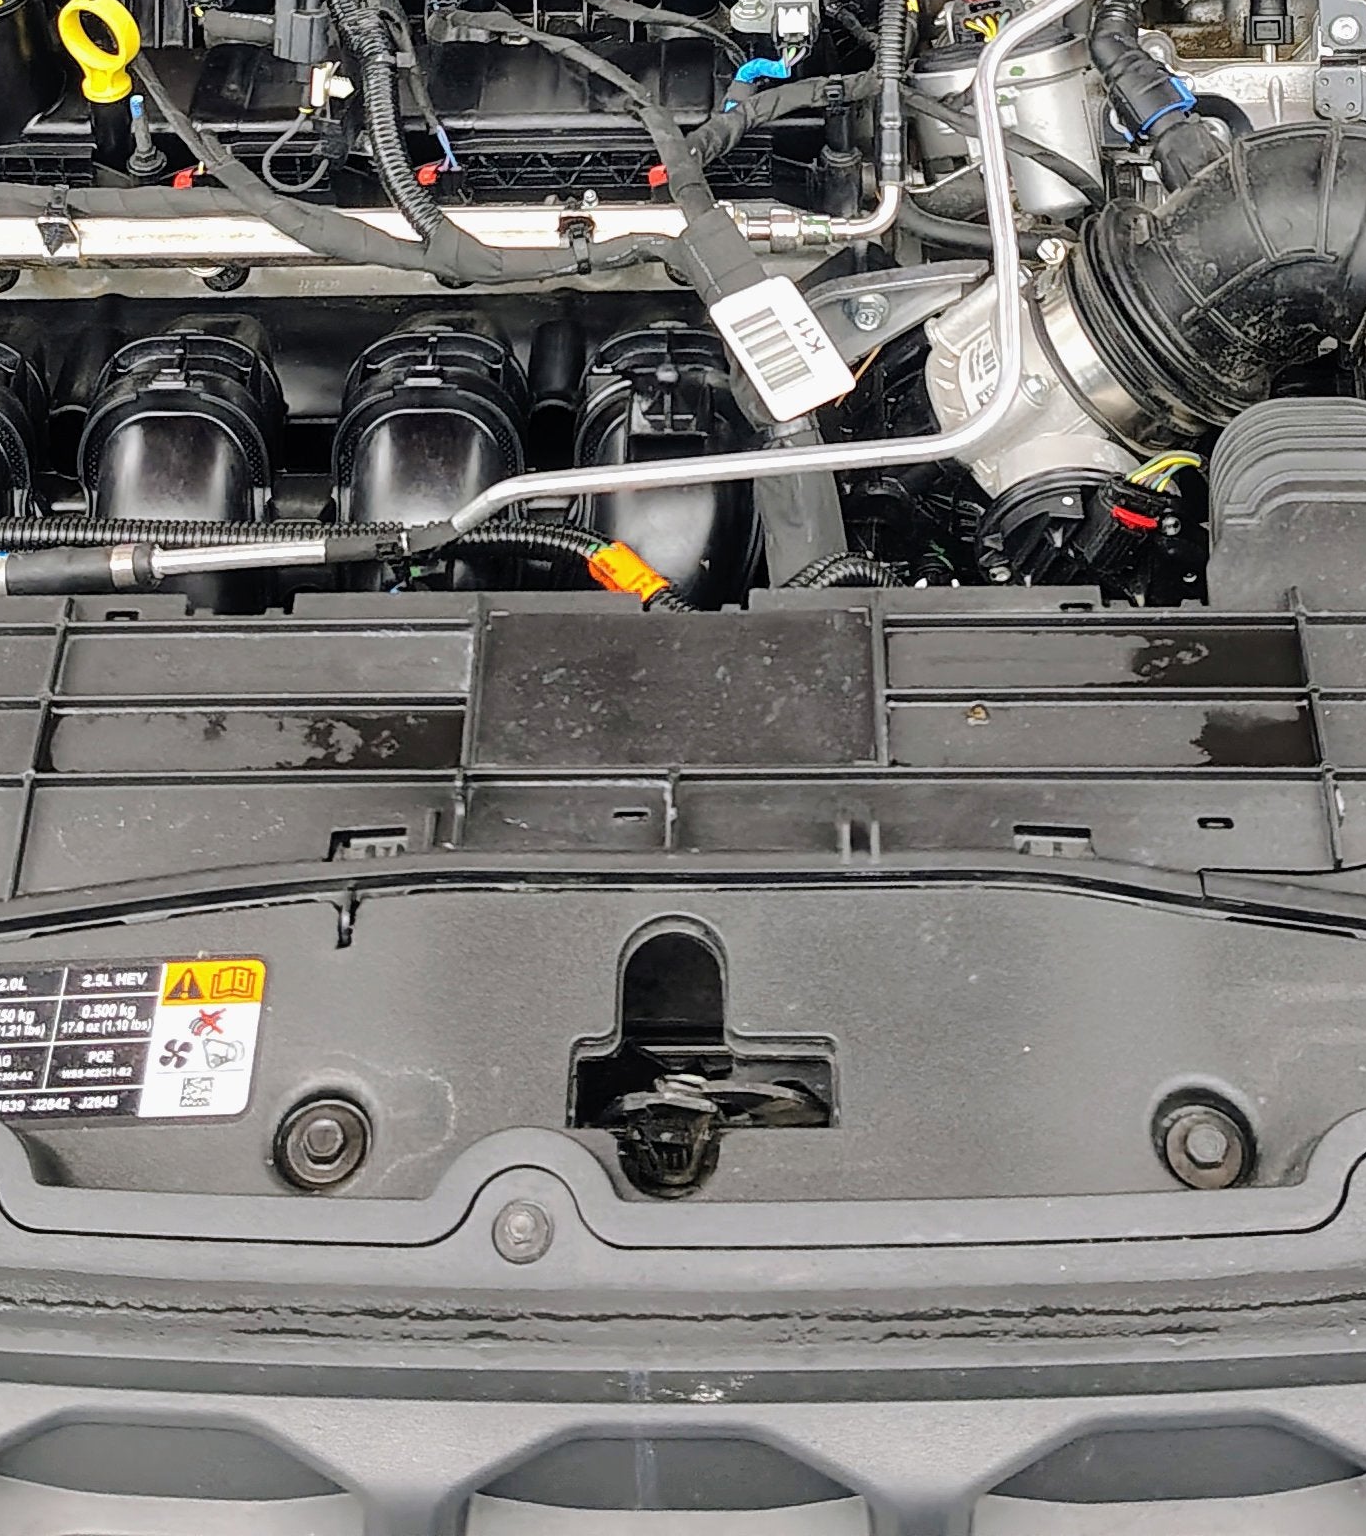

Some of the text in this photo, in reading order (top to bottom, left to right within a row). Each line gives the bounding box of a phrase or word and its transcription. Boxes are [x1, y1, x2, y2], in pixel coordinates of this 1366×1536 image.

[793, 318, 826, 354] K11
[81, 971, 148, 988] 2.5L HEV
[18, 1009, 35, 1024] kg
[81, 1003, 137, 1019] 0.500 kg
[86, 1023, 100, 1033] oz
[88, 1050, 114, 1063] POE
